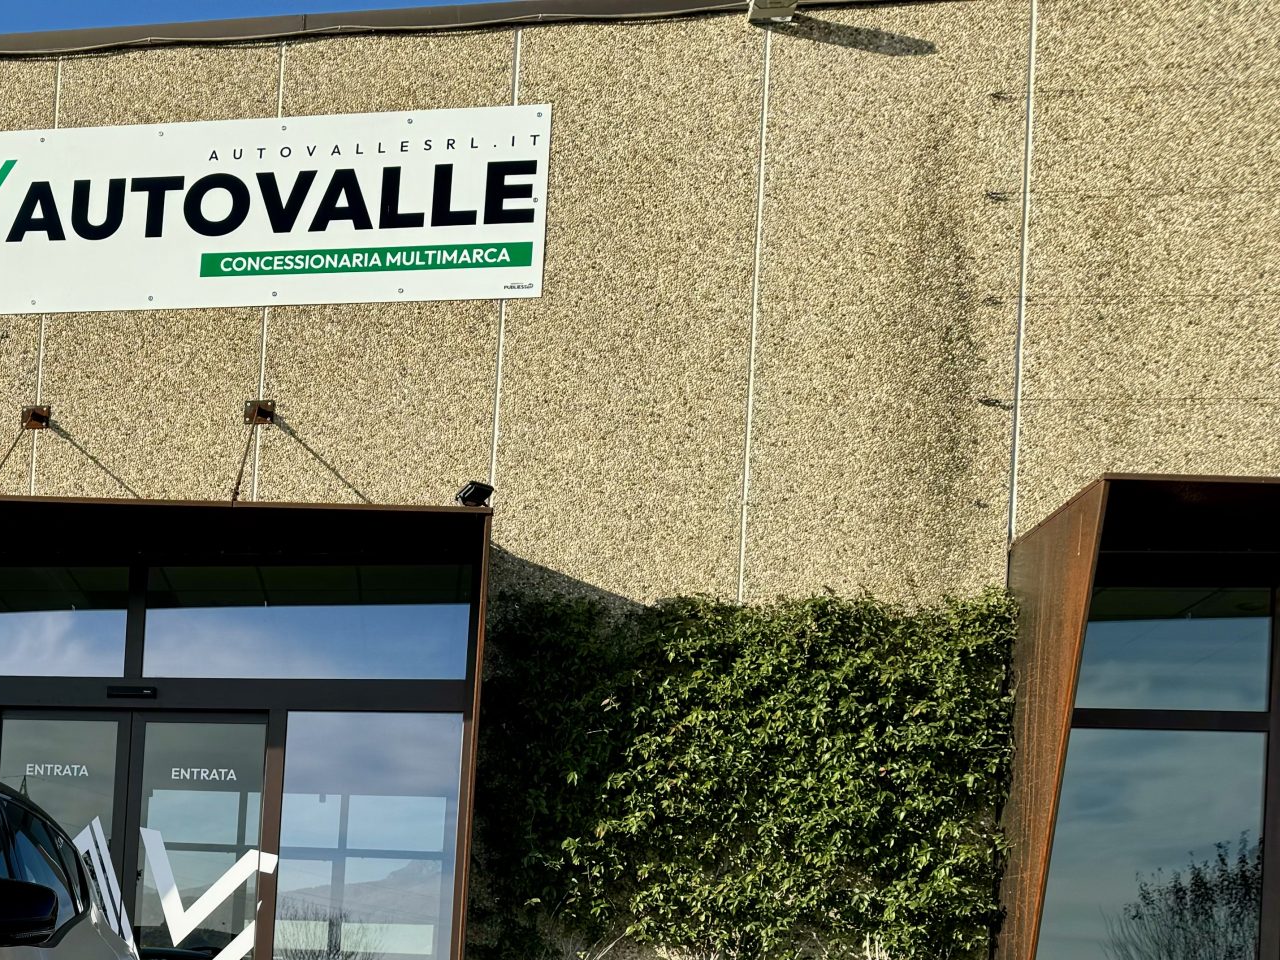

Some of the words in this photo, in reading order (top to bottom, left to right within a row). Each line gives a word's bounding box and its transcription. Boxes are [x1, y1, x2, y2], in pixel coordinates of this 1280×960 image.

[207, 133, 541, 162] AUTOVALLESRL.IT
[5, 159, 539, 243] AUTOVALLE
[219, 249, 383, 272] CONCESSIONARIA
[384, 246, 512, 267] MULTIMARCA
[25, 763, 89, 777] ENTRATA
[171, 767, 237, 781] ENTRATA
